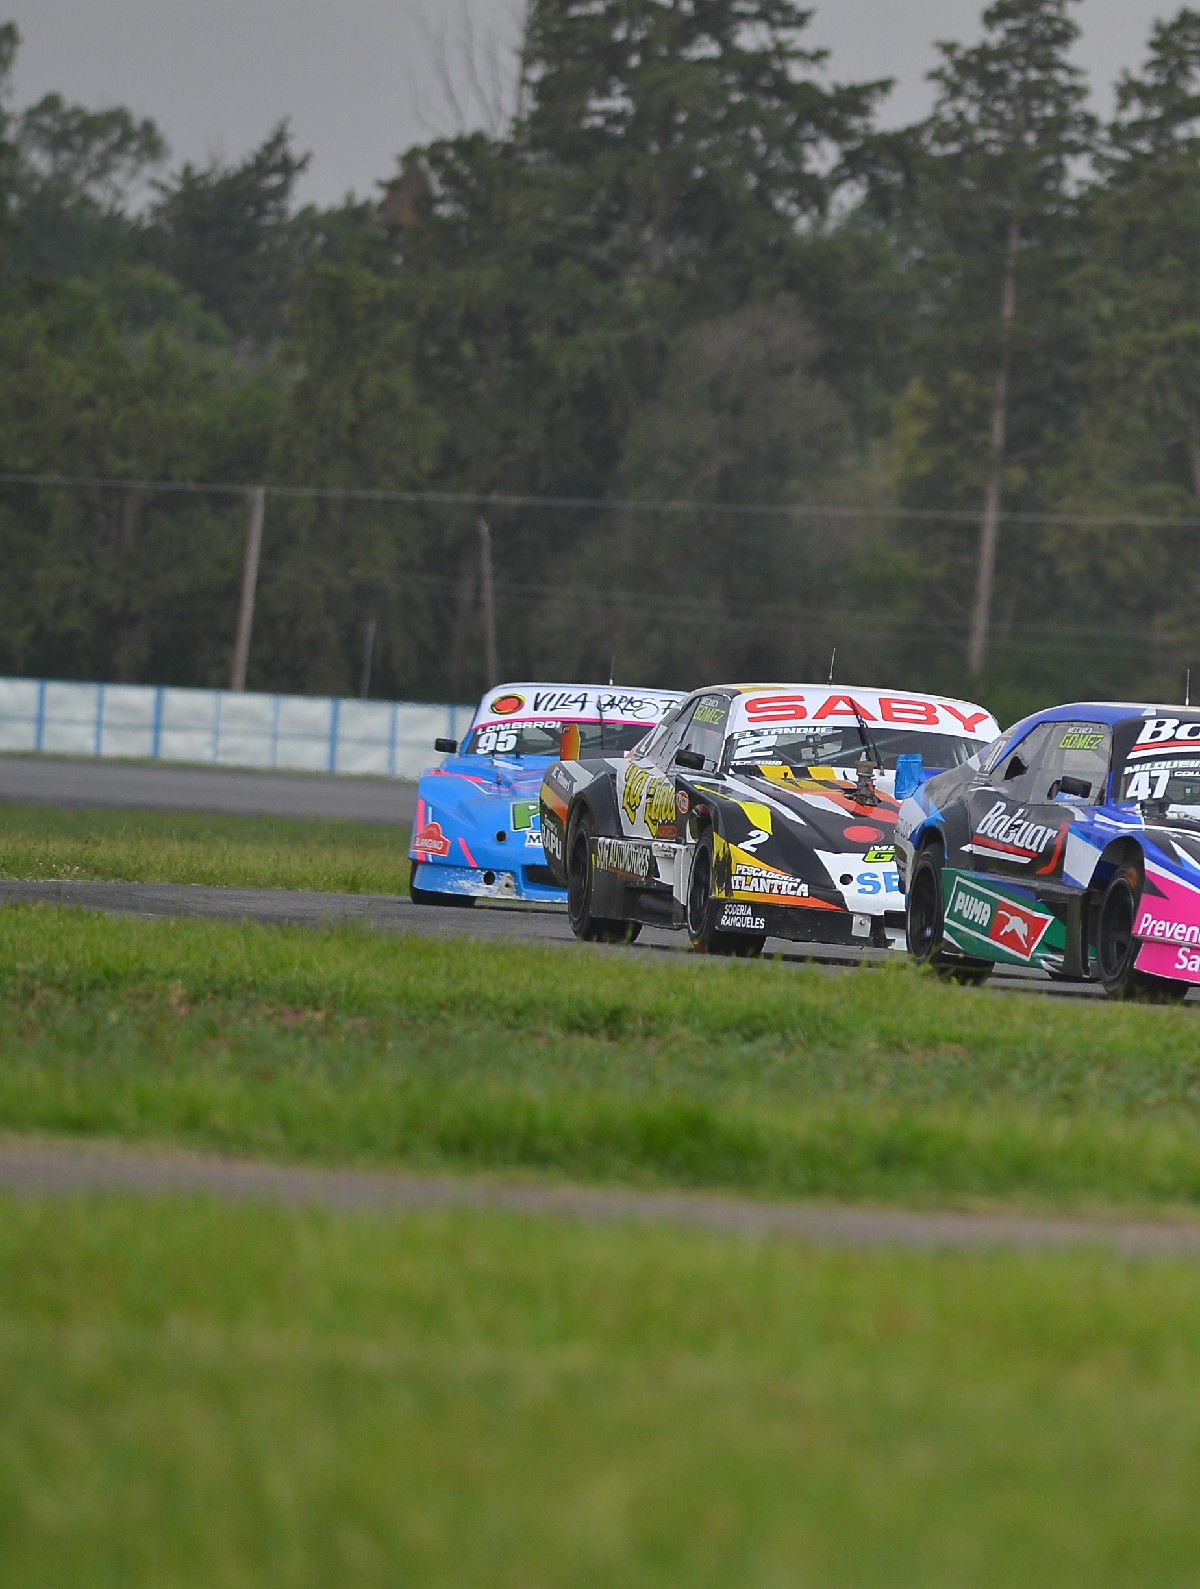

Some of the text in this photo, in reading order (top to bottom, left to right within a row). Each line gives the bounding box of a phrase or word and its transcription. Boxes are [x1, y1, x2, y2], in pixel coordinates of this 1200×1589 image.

[533, 692, 589, 712] VILLA
[597, 693, 659, 719] CARLOS
[693, 704, 725, 725] GOMEZ
[744, 694, 990, 733] SABY
[477, 721, 562, 735] LOMBARDI
[733, 731, 754, 739] EL
[477, 730, 517, 754] 95
[734, 735, 778, 759] 2
[1059, 733, 1105, 750] GOMEZ
[1126, 769, 1170, 801] 47
[737, 829, 769, 853] 2
[954, 890, 991, 927] PUMA
[721, 915, 765, 929] RANQUELES
